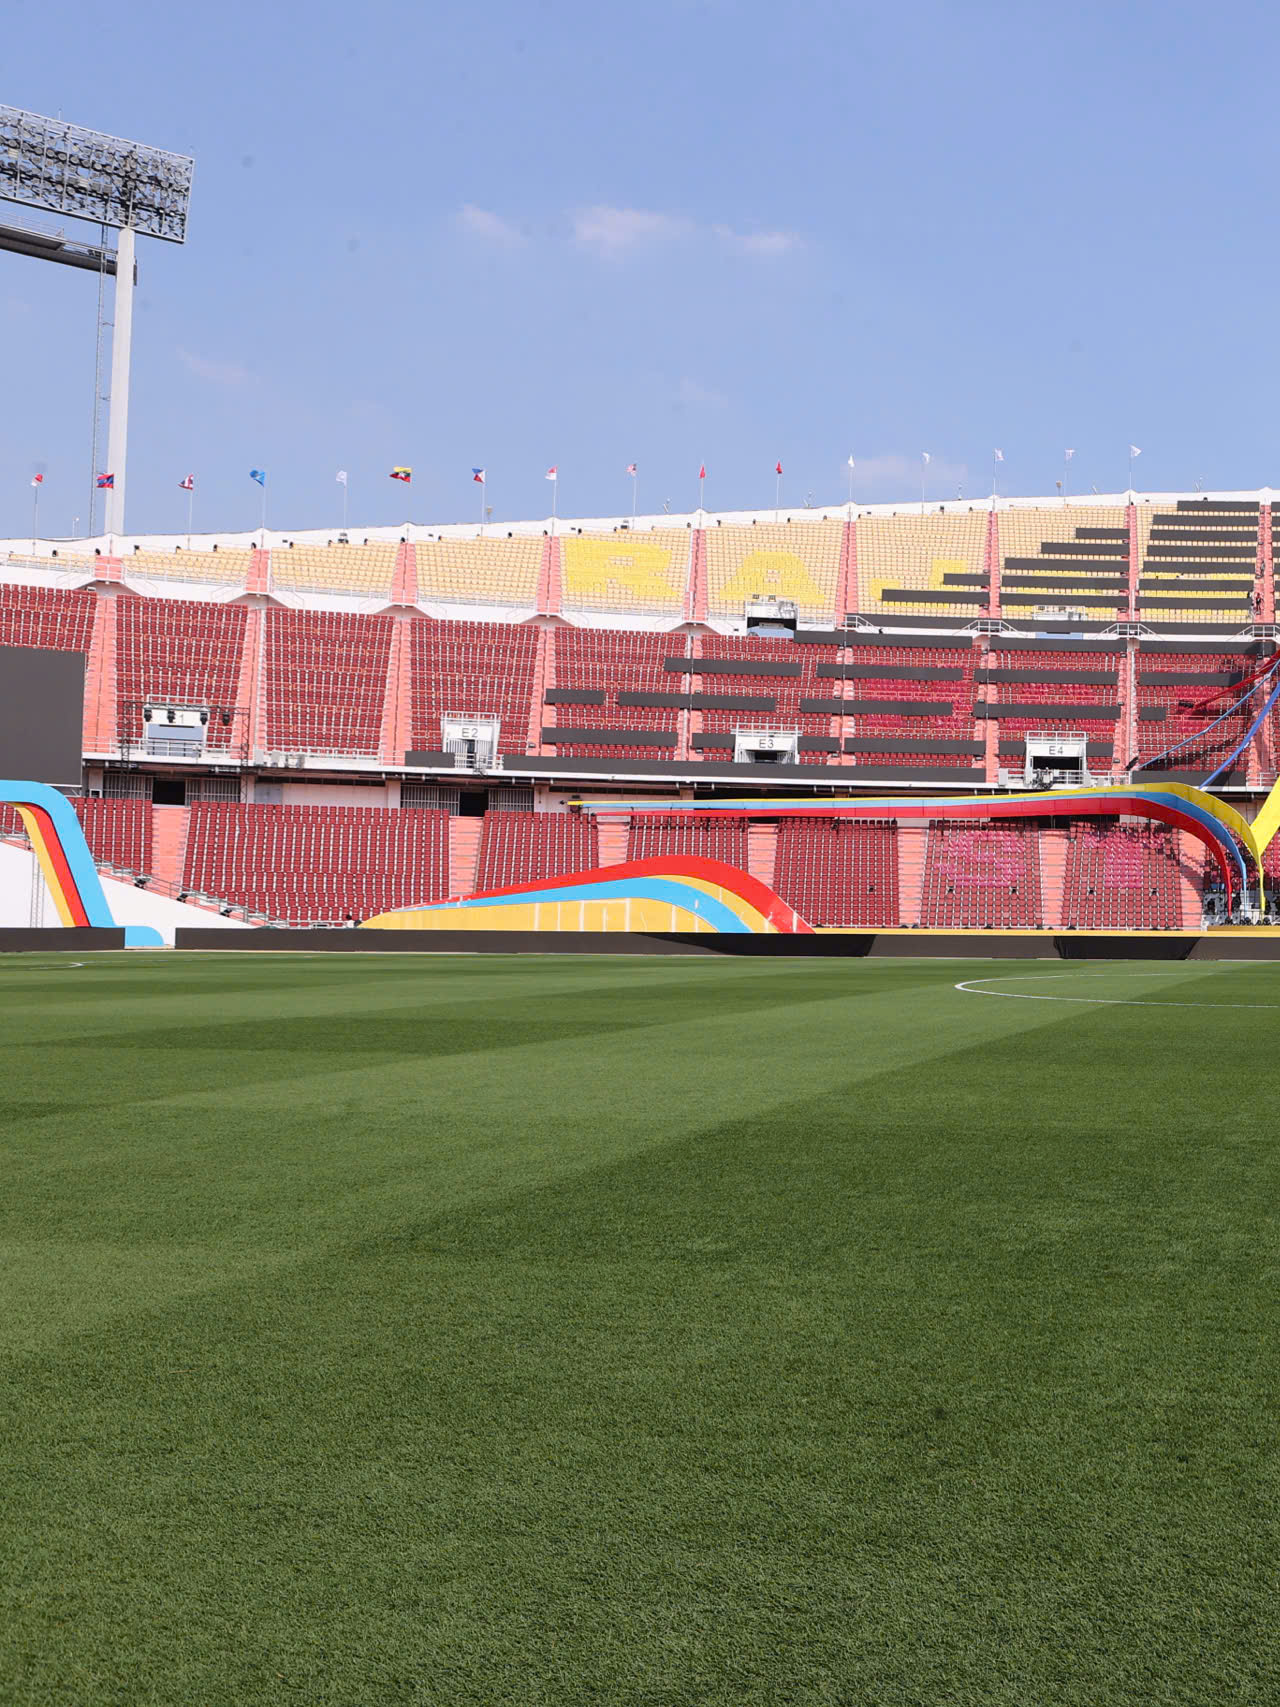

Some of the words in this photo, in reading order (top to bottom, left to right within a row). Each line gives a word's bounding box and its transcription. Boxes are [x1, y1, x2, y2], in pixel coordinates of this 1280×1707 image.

[461, 727, 479, 738] E2
[759, 738, 774, 749] E3
[1048, 745, 1064, 755] E4
